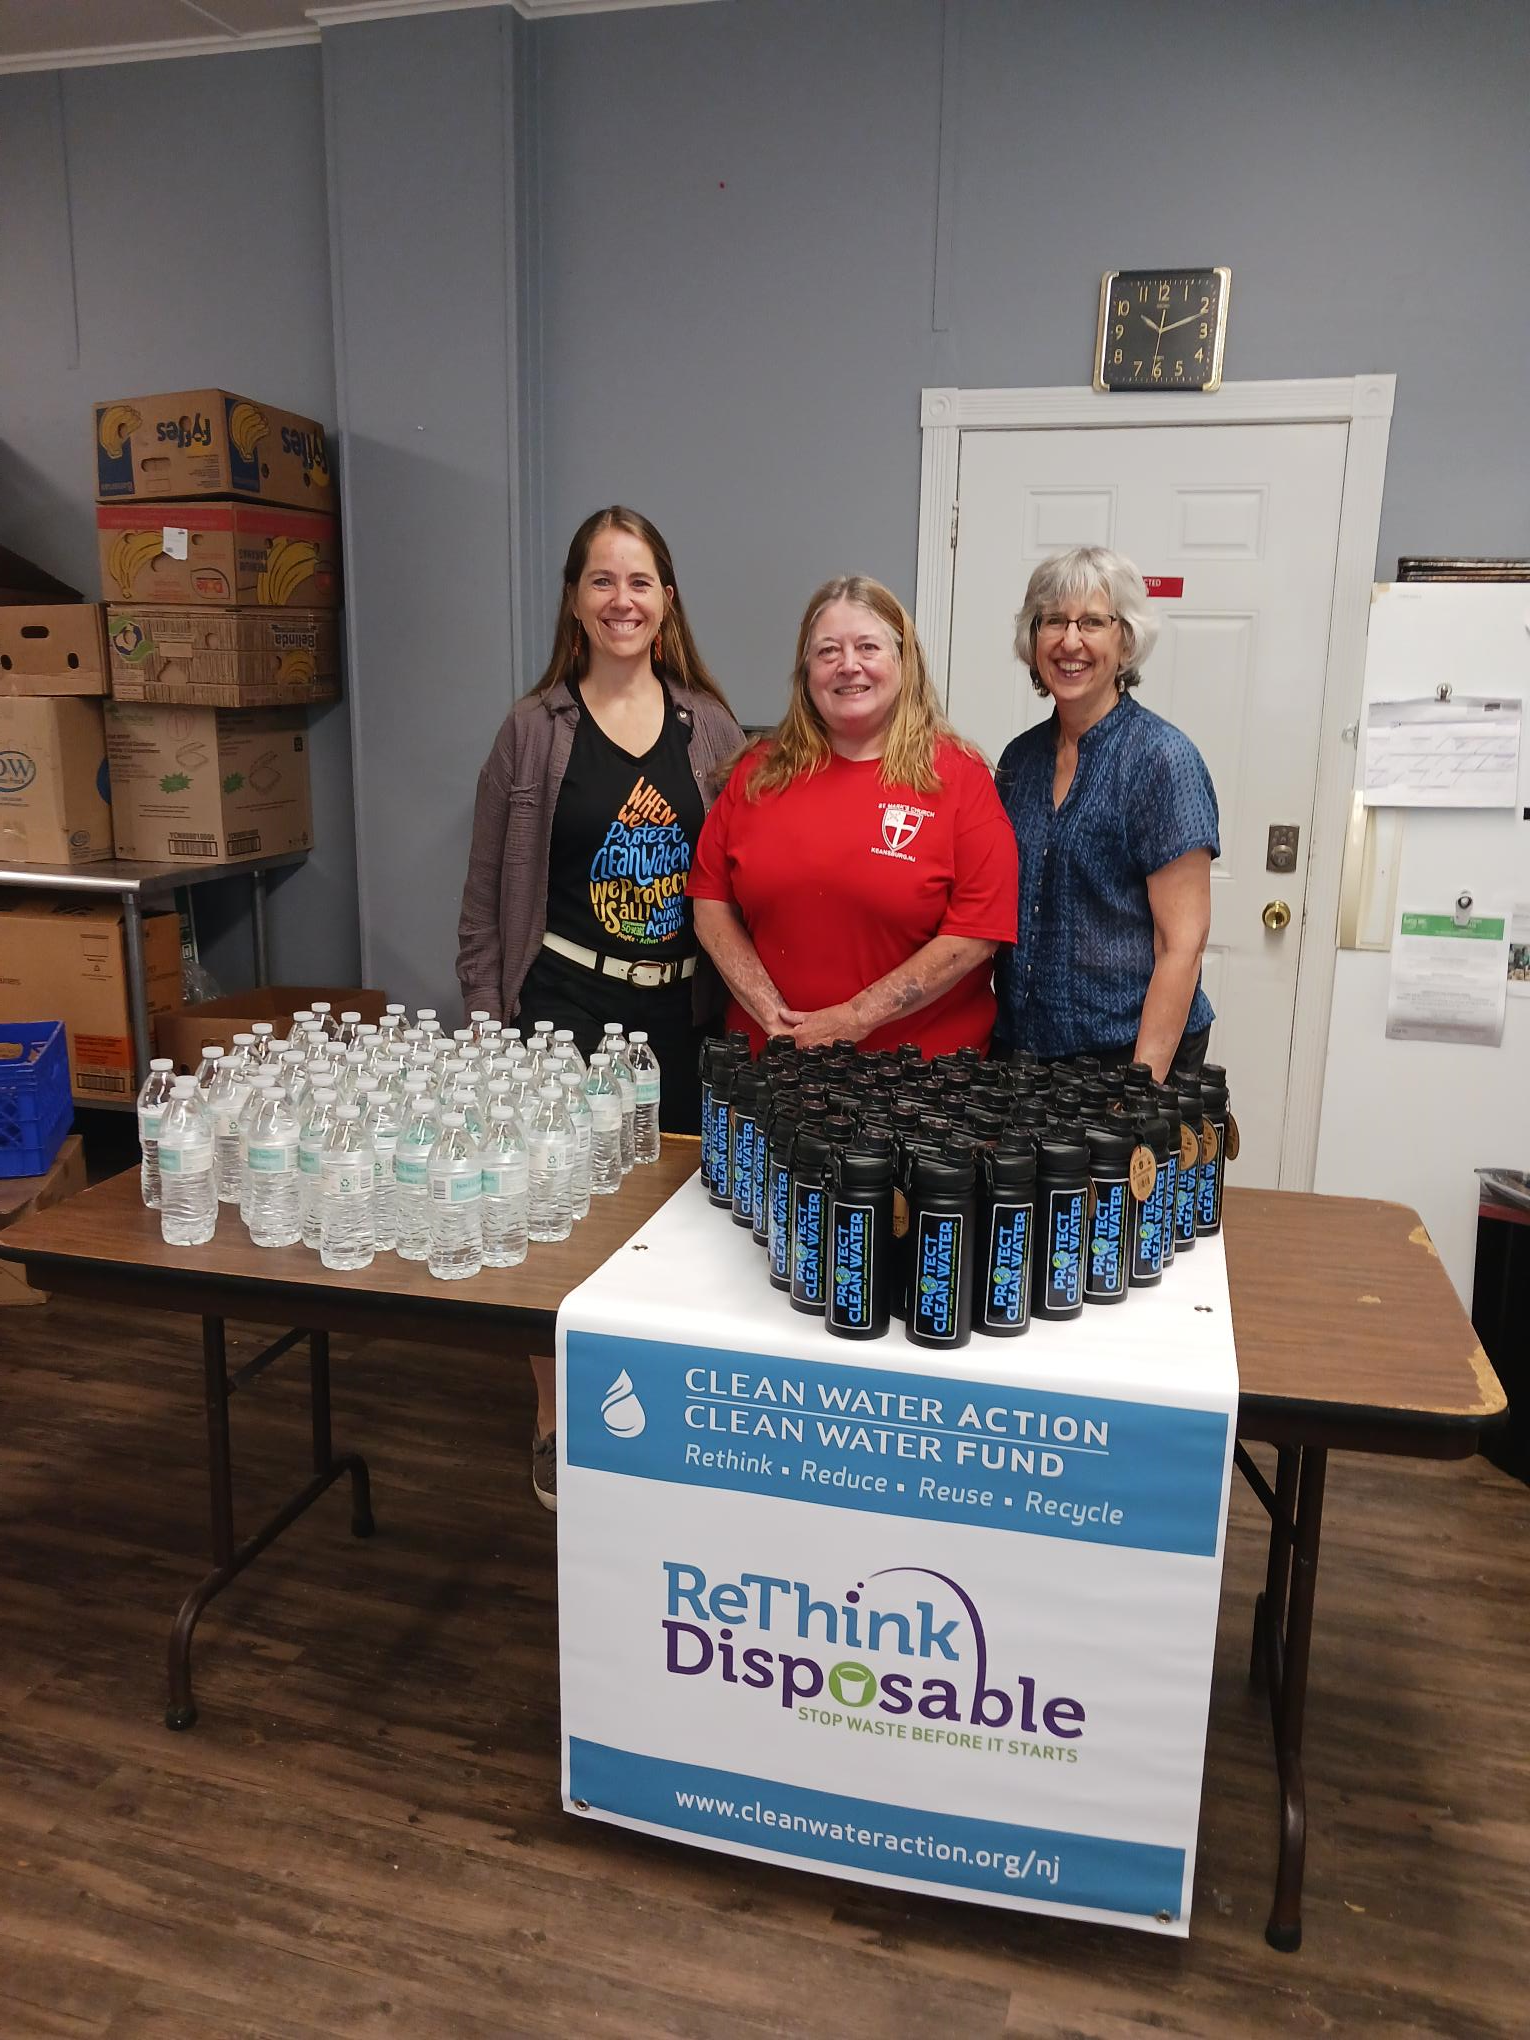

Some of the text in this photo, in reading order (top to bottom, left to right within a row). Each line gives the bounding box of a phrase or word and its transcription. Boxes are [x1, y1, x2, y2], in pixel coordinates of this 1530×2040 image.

[1117, 299, 1131, 317] 10
[1139, 285, 1149, 303] 11
[1158, 284, 1171, 301] 12
[1184, 284, 1189, 302] 1
[1199, 322, 1208, 339] 3
[1200, 296, 1210, 315] 2
[1113, 348, 1123, 365] 8
[1115, 324, 1125, 340] 9
[1133, 360, 1143, 377] 7
[1153, 361, 1162, 378] 6
[1174, 360, 1184, 377] 5
[1193, 346, 1204, 364] 4
[274, 633, 316, 648] Belinda
[604, 821, 685, 848] Protect
[627, 776, 678, 826] WHEN
[718, 1107, 728, 1196] CLEAN WATER
[742, 1122, 753, 1214] CLEAN WATER
[754, 1136, 765, 1230] CLEAN WATER
[1165, 1157, 1177, 1207] WATER
[776, 1171, 788, 1274] CLEAN WATER
[1091, 1199, 1110, 1276] PROTECT
[1105, 1185, 1122, 1290] CLEAN WATER
[1140, 1189, 1156, 1260] PROTEC
[1151, 1170, 1165, 1271] CLEAN WATER
[1183, 1192, 1195, 1238] CLEAN
[1203, 1180, 1215, 1223] CLEAN
[796, 1203, 809, 1282] PROTECT
[805, 1192, 820, 1299] CLEAN WATER
[835, 1224, 851, 1308] PROTECT
[848, 1212, 864, 1324] CLEAN WATER
[920, 1233, 938, 1317] PROTECT
[933, 1220, 953, 1333] CLEAN WATER
[993, 1226, 1012, 1307] PROTECT
[1006, 1210, 1026, 1321] CLEAN WATER
[1052, 1211, 1070, 1290] PROTECT
[1067, 1195, 1082, 1303] CLEAN WATER
[684, 1367, 1109, 1447] CLEAN WATER ACTION
[684, 1404, 1065, 1478] CLEAN WATER FUND
[684, 1443, 1124, 1526] Rethink Reduce Reuse Recycle
[662, 1561, 960, 1662] ReThink
[662, 1619, 1086, 1740] Disposable
[797, 1706, 1079, 1764] STOP WASTE BEFORE IT STARTS
[675, 1790, 1061, 1886] www.cleanwateraction.org/nj
